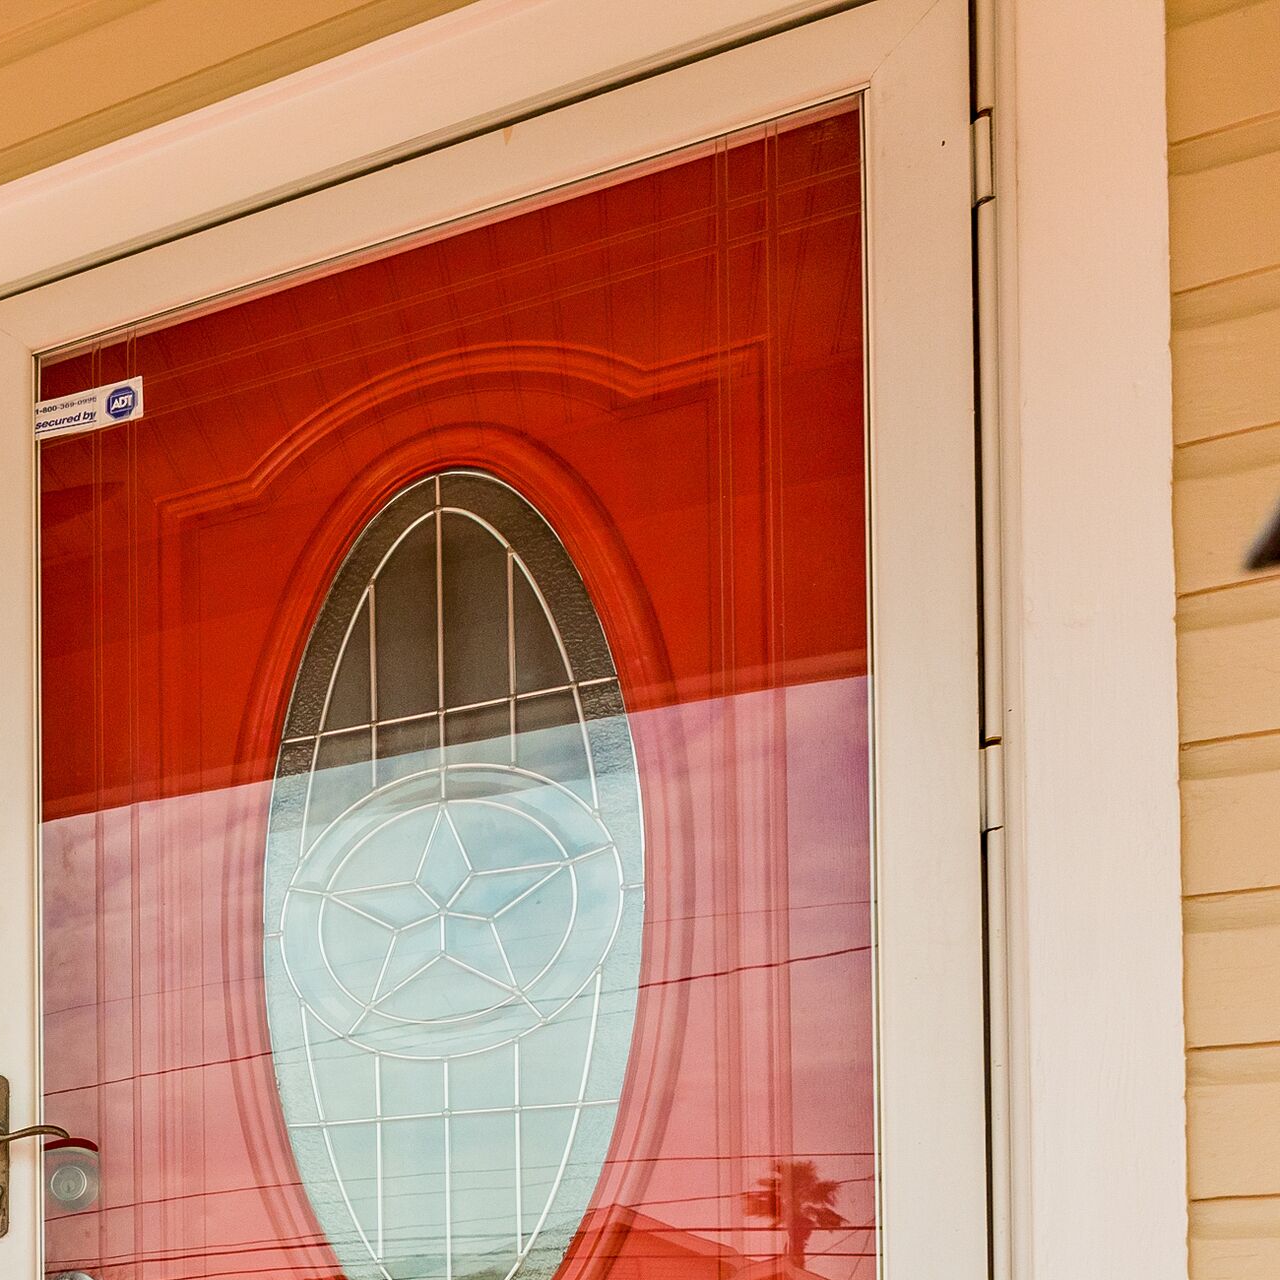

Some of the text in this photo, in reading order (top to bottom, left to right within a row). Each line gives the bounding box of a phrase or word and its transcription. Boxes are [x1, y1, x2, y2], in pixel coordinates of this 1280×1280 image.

[111, 394, 133, 411] ADT
[35, 411, 97, 430] secured by
